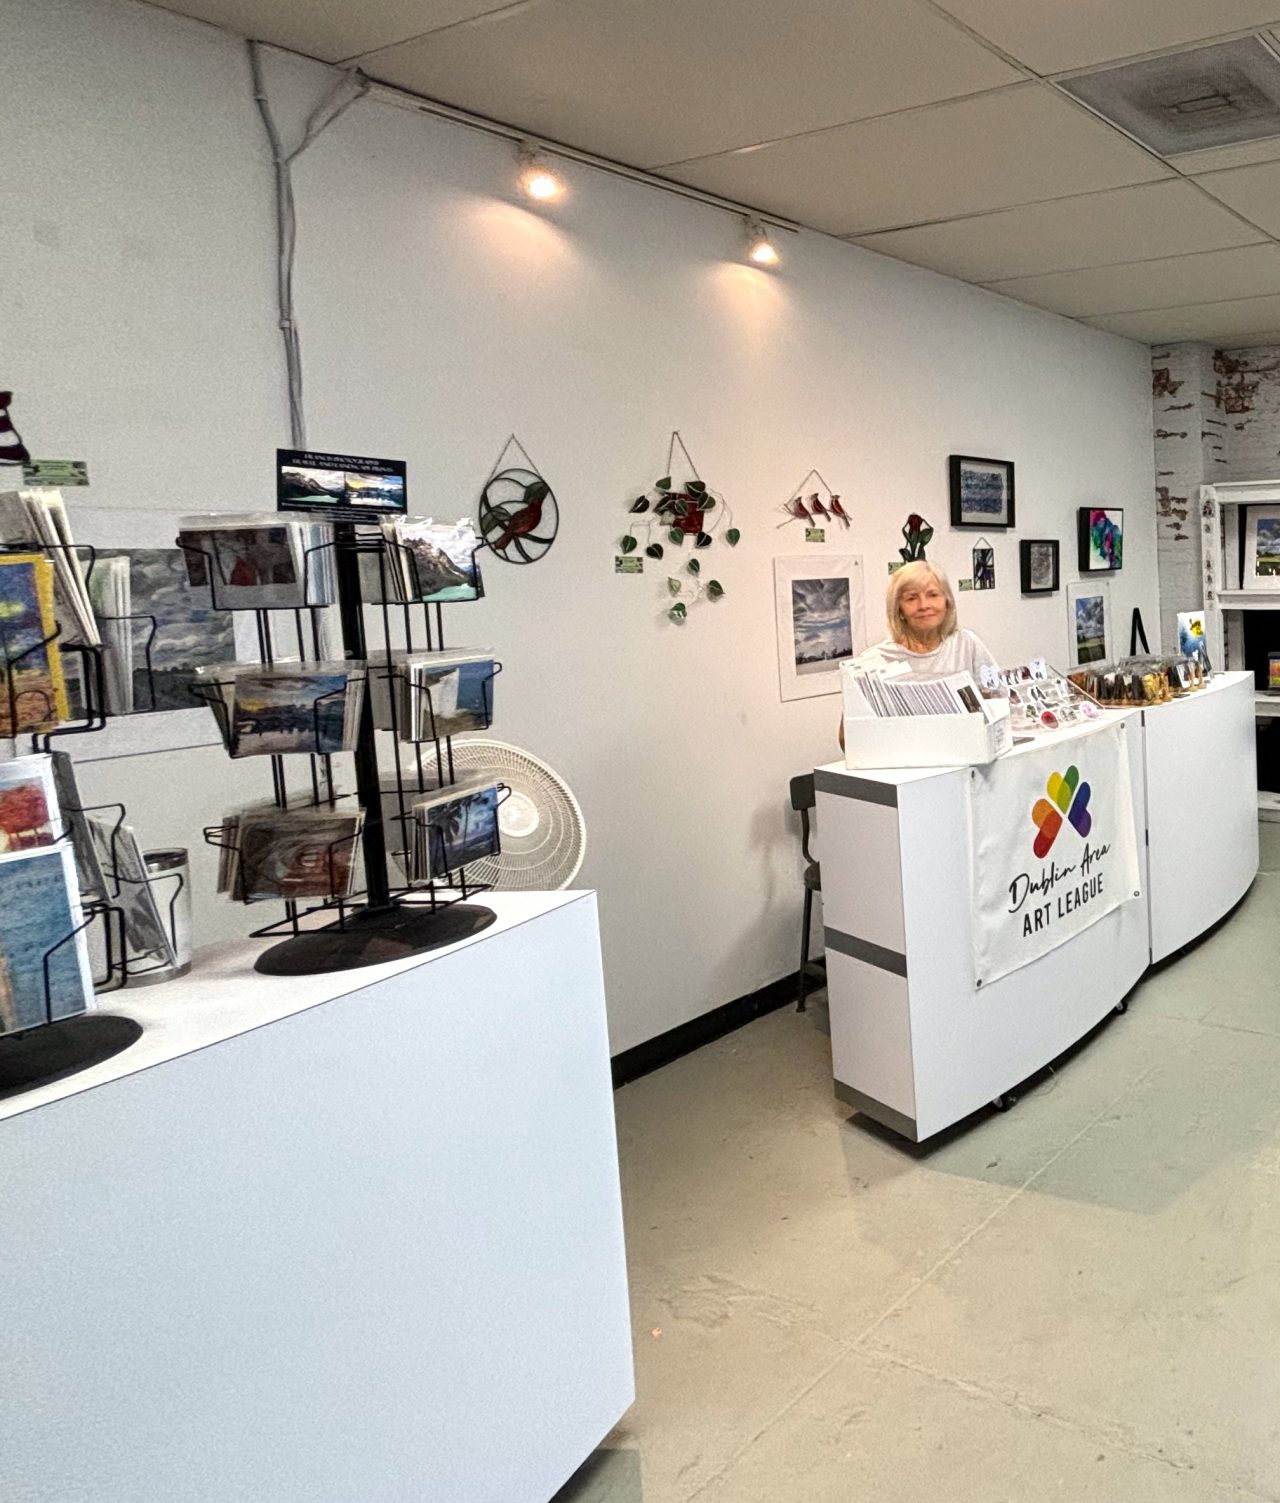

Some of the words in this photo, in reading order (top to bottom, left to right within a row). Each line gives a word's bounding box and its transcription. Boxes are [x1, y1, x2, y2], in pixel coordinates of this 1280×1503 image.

[1008, 861, 1077, 914] Dublin
[1080, 842, 1112, 877] Area
[1023, 902, 1051, 938] ART
[1057, 872, 1105, 918] LEAGUE
